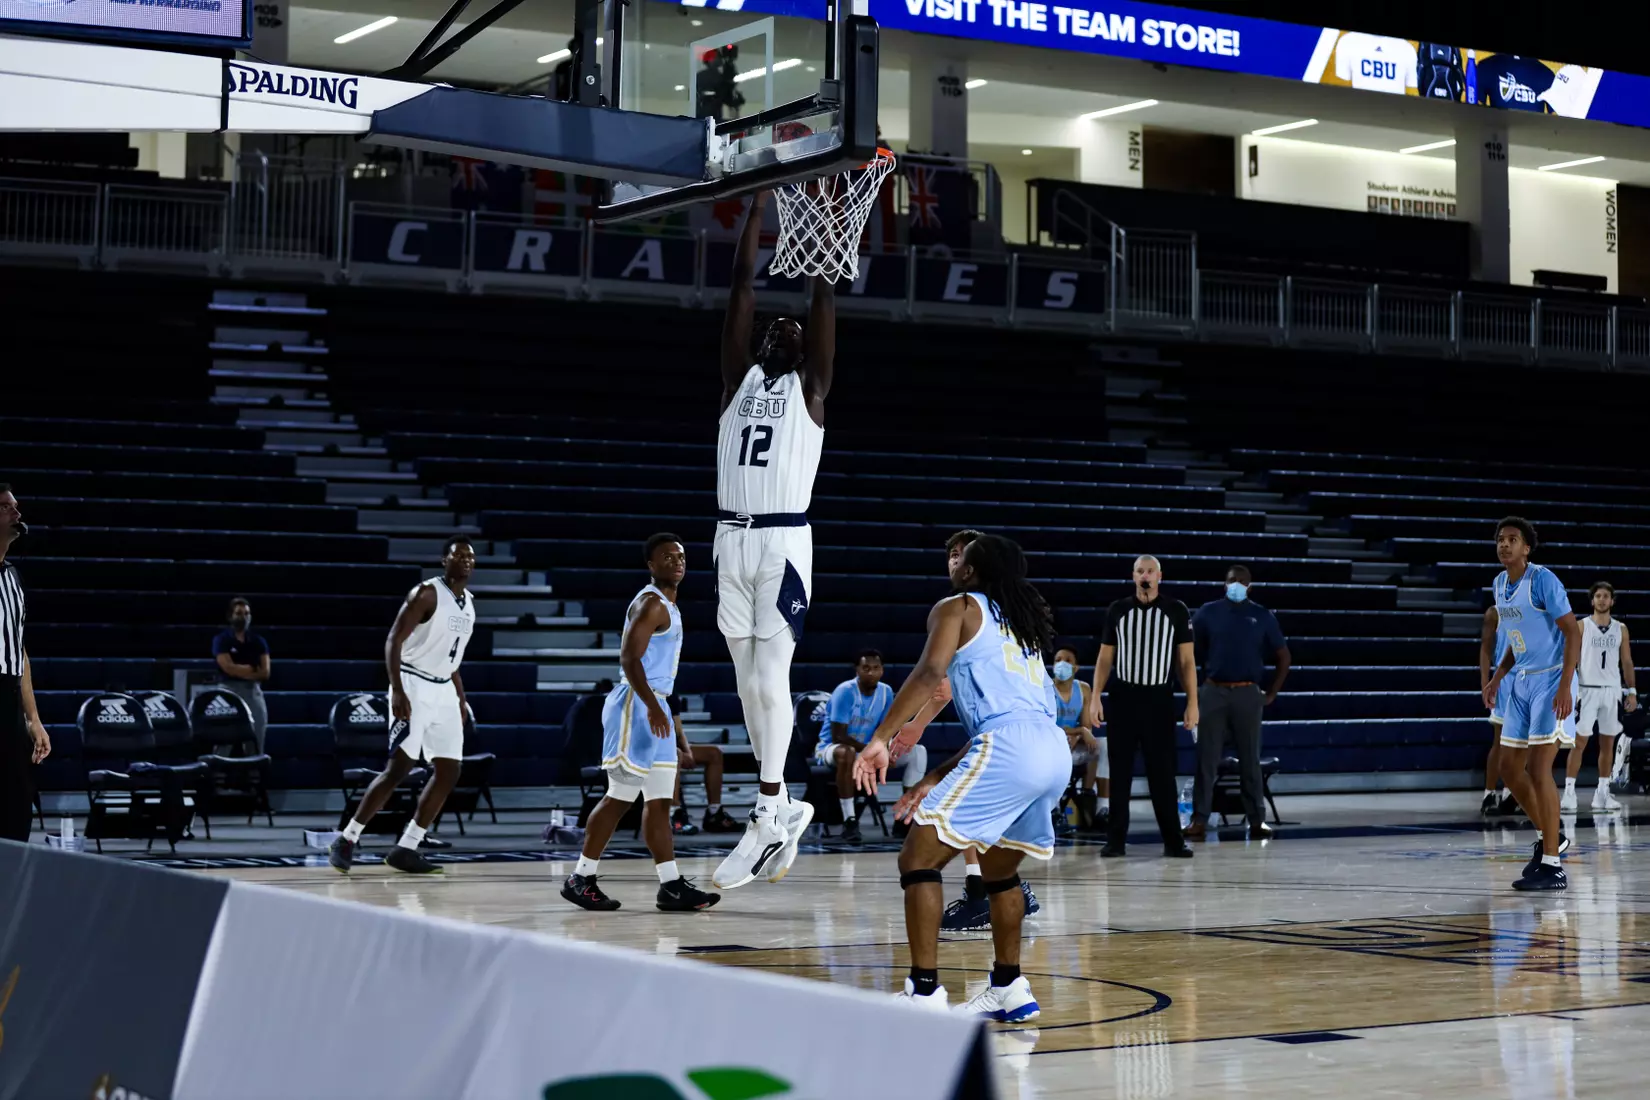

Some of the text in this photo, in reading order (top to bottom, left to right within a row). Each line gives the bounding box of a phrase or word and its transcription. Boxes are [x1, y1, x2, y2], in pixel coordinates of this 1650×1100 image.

[905, 0, 1240, 57] VISIT THE TEAM STORE!
[1361, 59, 1396, 80] CBU
[1514, 90, 1536, 103] CBU
[1128, 130, 1140, 171] MEN
[1605, 189, 1616, 253] WOMEN
[738, 396, 786, 418] CBU
[738, 424, 773, 467] 12
[449, 636, 460, 663] 4
[1601, 650, 1606, 670] 1
[97, 714, 135, 723] adidas
[204, 707, 239, 716] adidas
[349, 714, 386, 723] adidas
